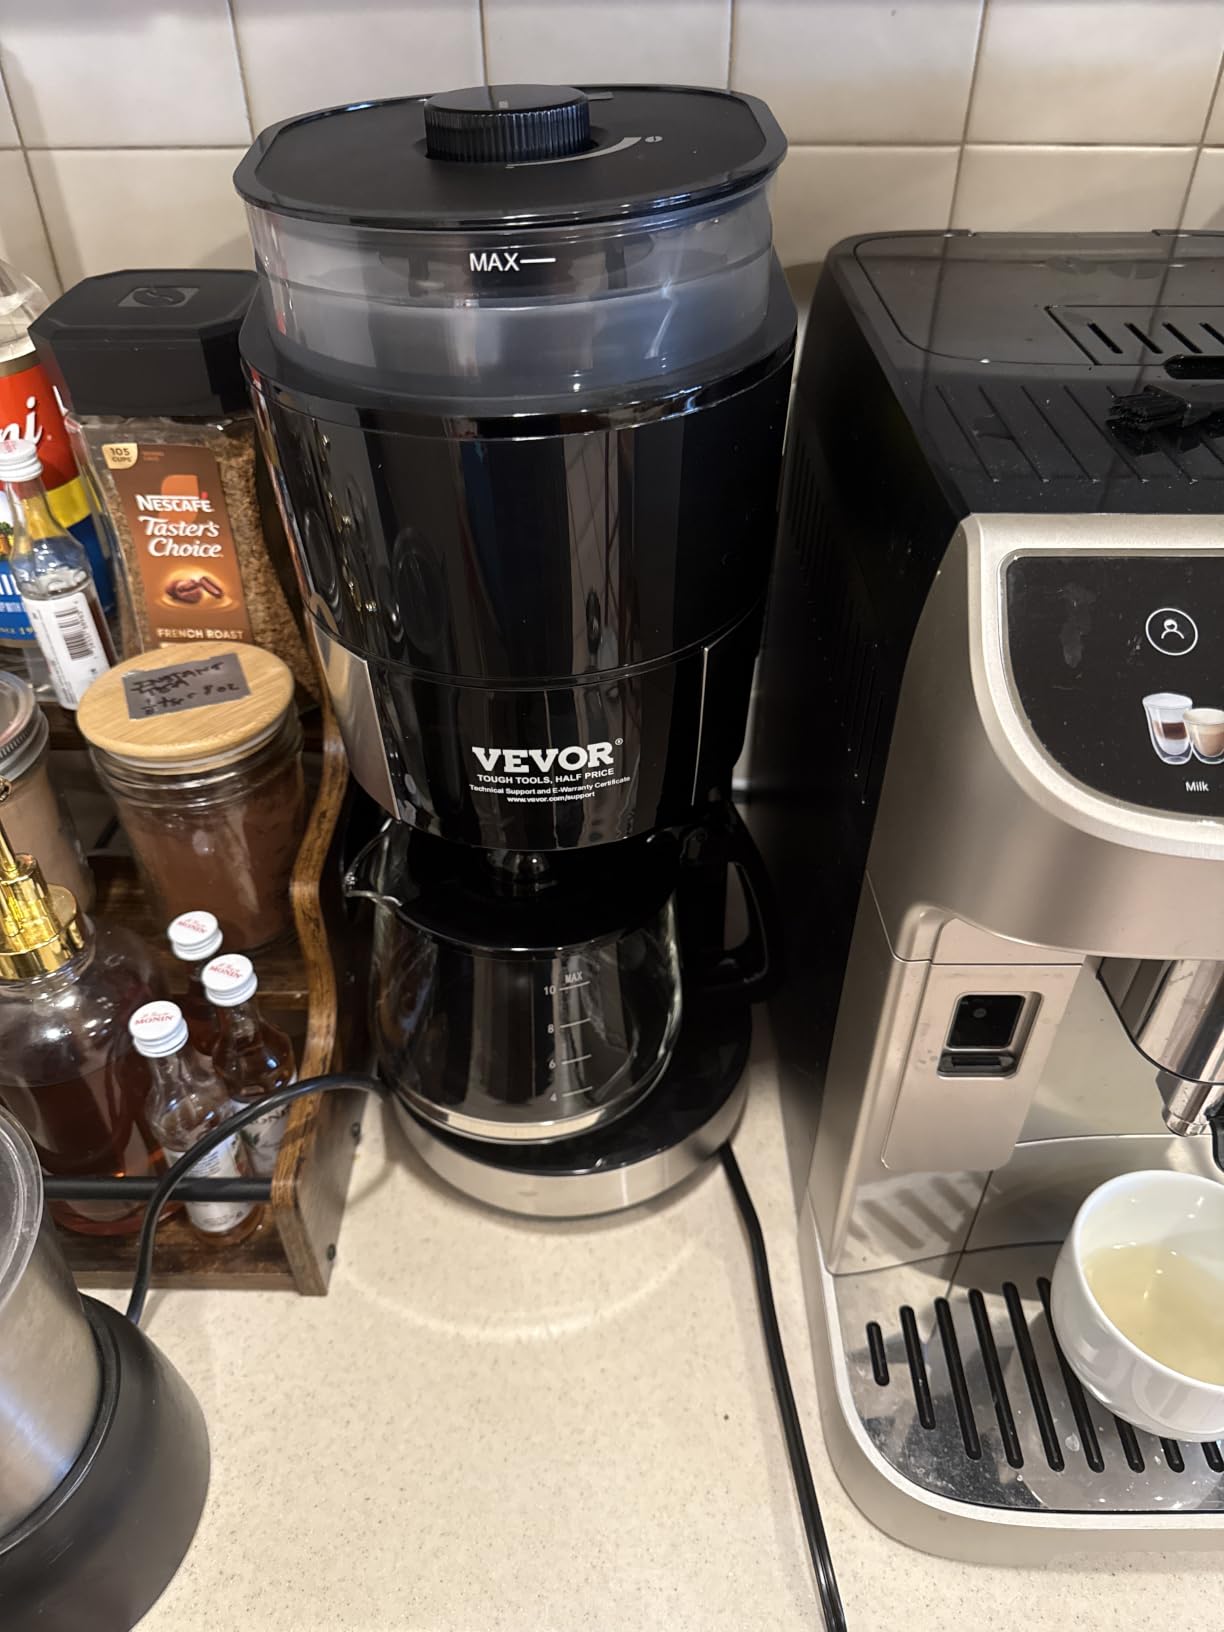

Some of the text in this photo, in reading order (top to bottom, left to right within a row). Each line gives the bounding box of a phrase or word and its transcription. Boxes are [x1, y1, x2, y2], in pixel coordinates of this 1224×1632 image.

[469, 252, 521, 272] MAX
[110, 447, 130, 456] 105
[138, 515, 220, 537] Taster's
[148, 537, 224, 558] Choice
[156, 628, 204, 639] FRENCH
[207, 629, 243, 640] ROAST
[477, 767, 614, 785] TOUGH TOOLS, HALF PRICE
[469, 784, 504, 794] Technical
[505, 787, 536, 796] Support
[552, 784, 593, 795] E-Warranty
[594, 776, 631, 789] Certificate
[1185, 781, 1210, 792] Milk
[506, 791, 596, 803] www.vevor.com/support
[565, 971, 583, 984] MAX
[544, 985, 556, 995] 10
[547, 1024, 555, 1034] 8
[549, 1059, 556, 1069] 6
